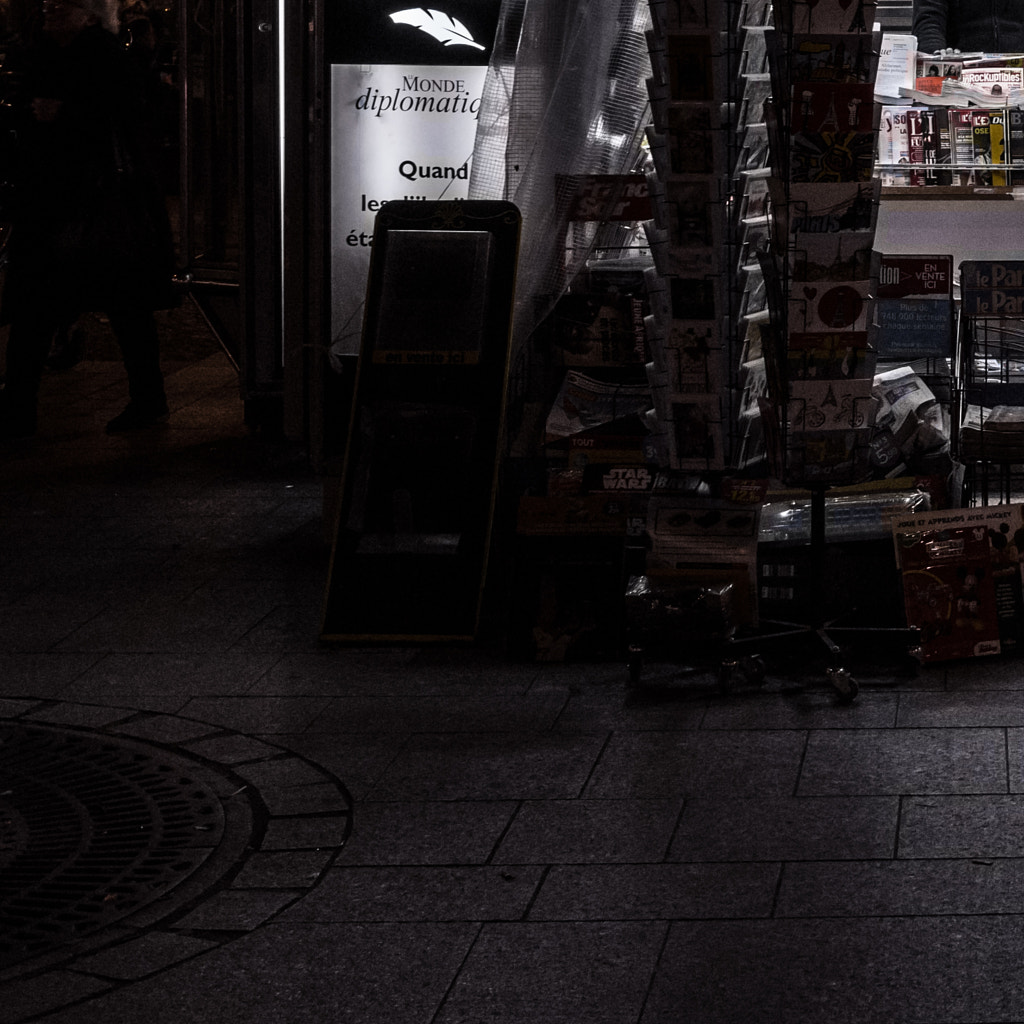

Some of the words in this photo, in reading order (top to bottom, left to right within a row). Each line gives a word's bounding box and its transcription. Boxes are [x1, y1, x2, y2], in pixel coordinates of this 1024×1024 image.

[402, 75, 466, 94] MONDE
[398, 160, 468, 181] Quand
[923, 263, 938, 272] EN
[914, 271, 947, 282] VENTE
[976, 270, 990, 288] le
[924, 281, 938, 290] ICI
[976, 296, 990, 314] le
[571, 437, 595, 448] TOUT
[608, 468, 649, 480] STAR
[602, 478, 652, 490] WARS
